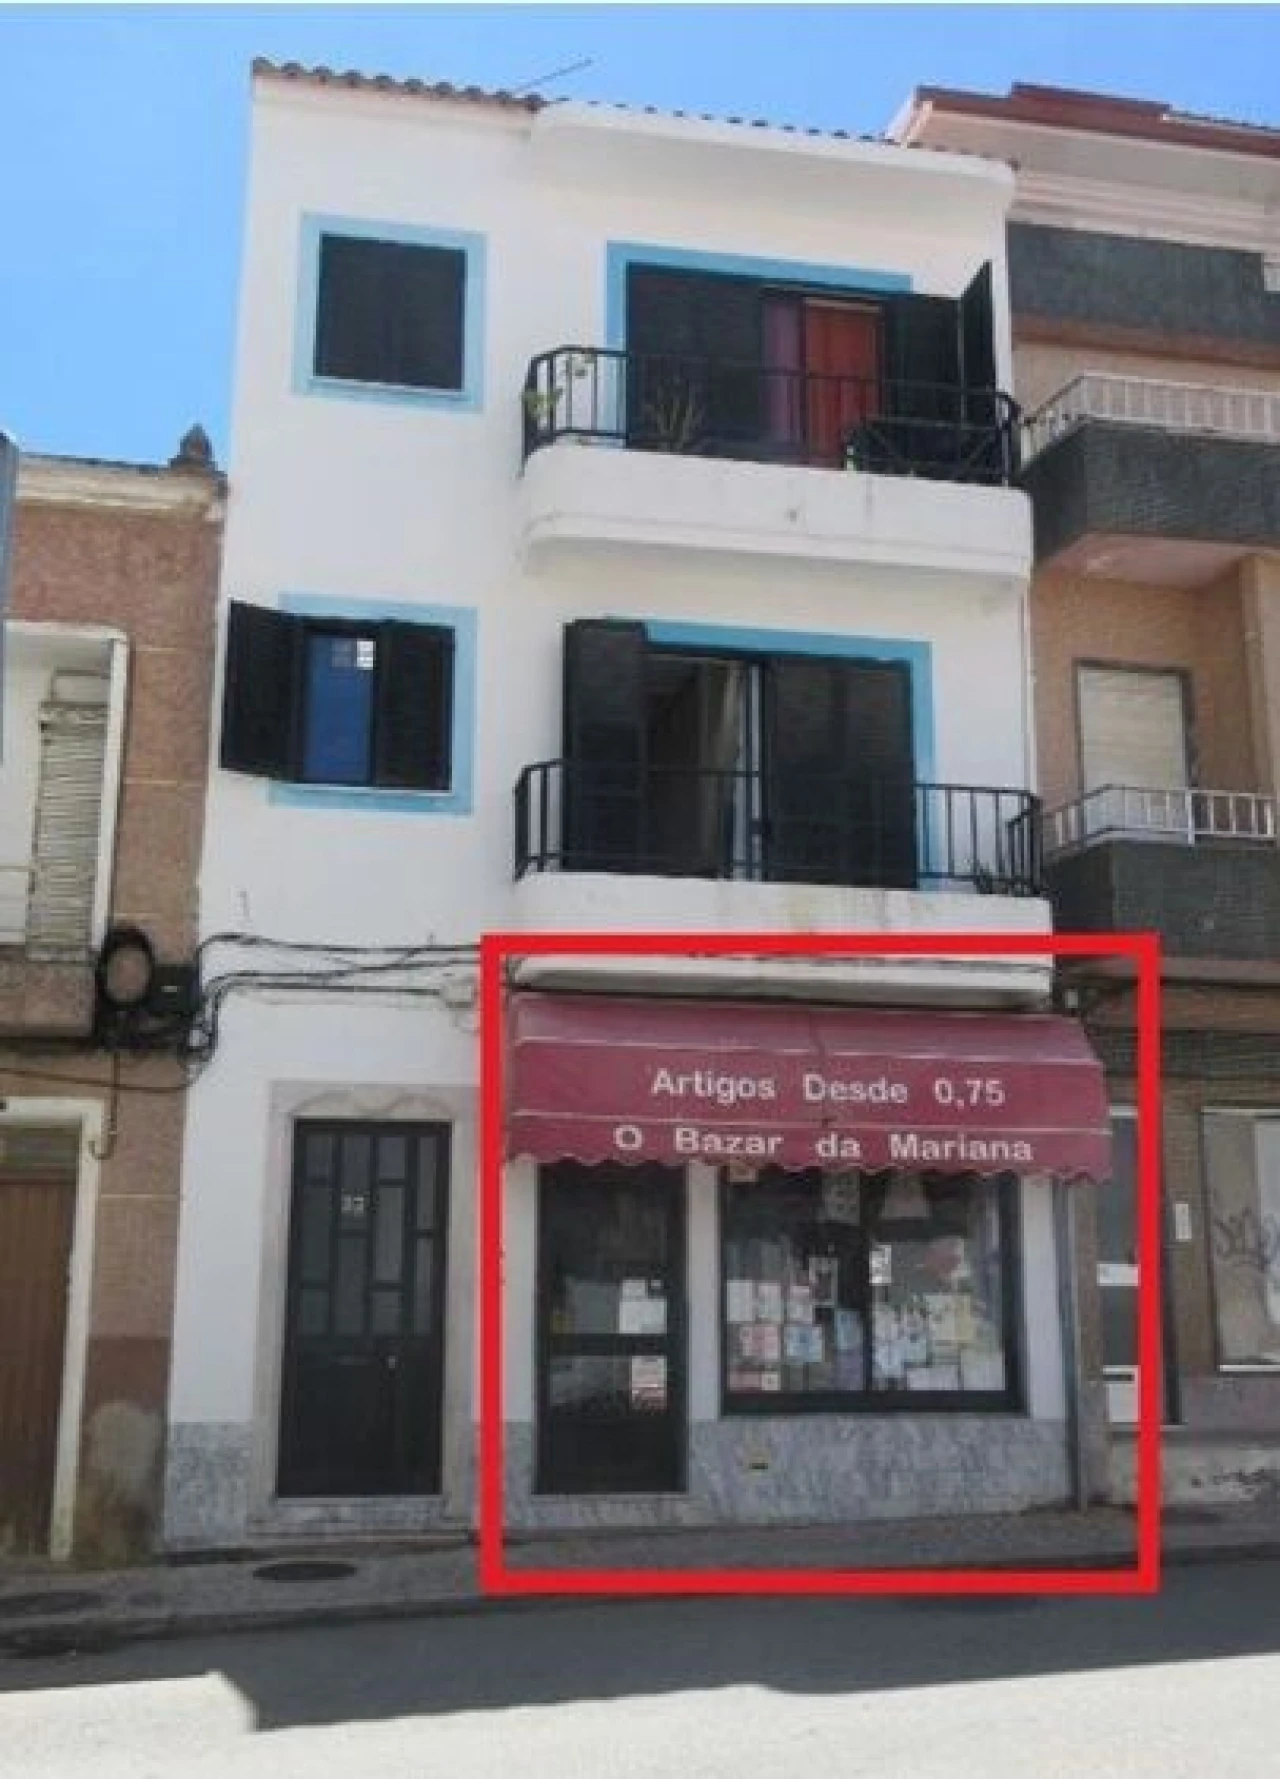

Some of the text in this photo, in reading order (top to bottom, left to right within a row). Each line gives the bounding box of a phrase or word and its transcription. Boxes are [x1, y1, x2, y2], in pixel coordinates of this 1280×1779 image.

[651, 1068, 776, 1105] Artigos
[802, 1073, 908, 1104] Desde
[613, 1125, 1034, 1161] O Bazar da Mariana
